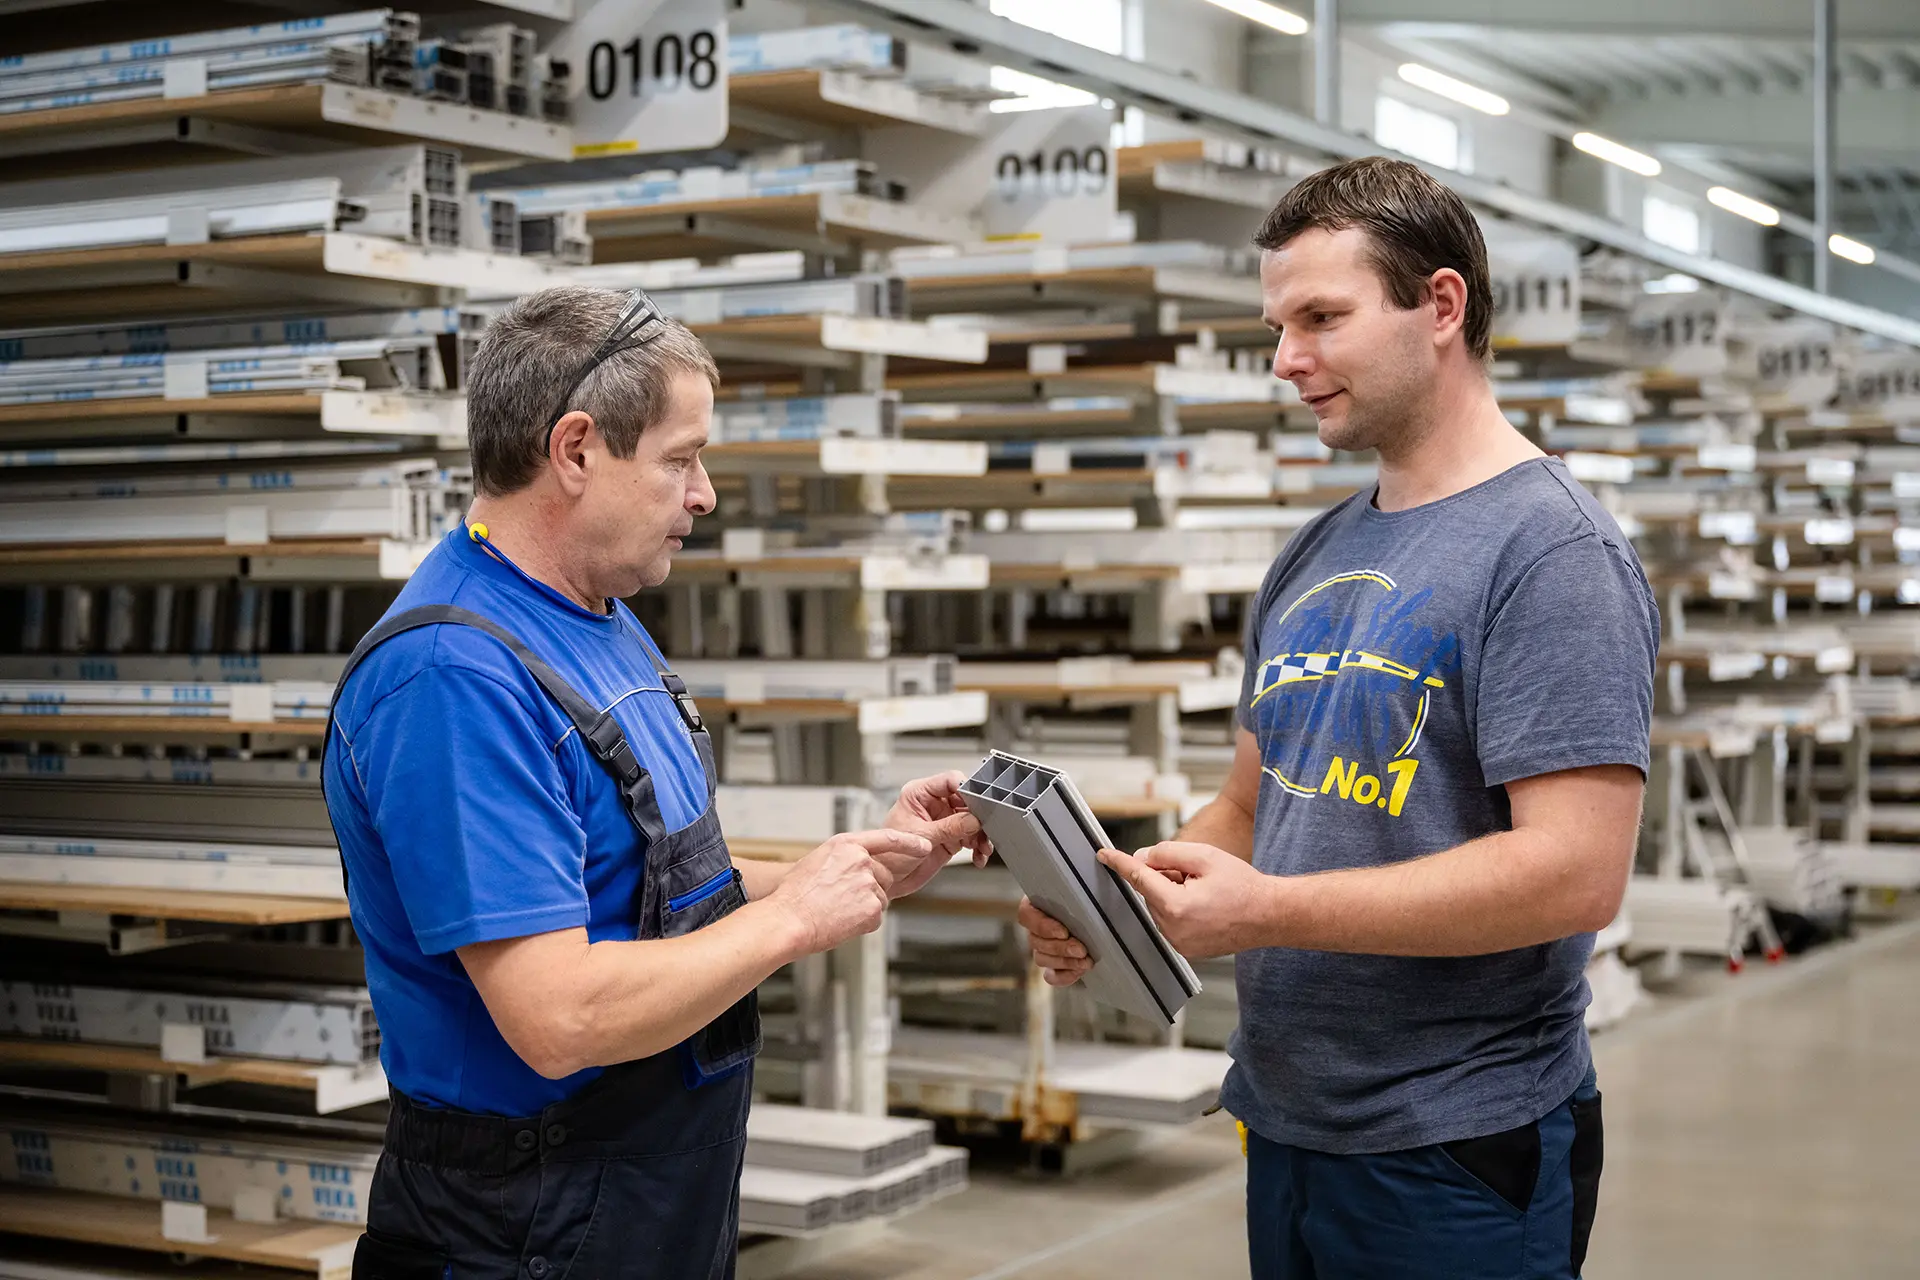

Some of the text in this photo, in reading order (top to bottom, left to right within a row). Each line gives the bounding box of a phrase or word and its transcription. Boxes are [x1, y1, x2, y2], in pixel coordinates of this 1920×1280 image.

[588, 29, 717, 101] 0108
[996, 146, 1108, 203] 0109
[1320, 756, 1419, 817] No.1
[204, 1027, 236, 1047] EKA
